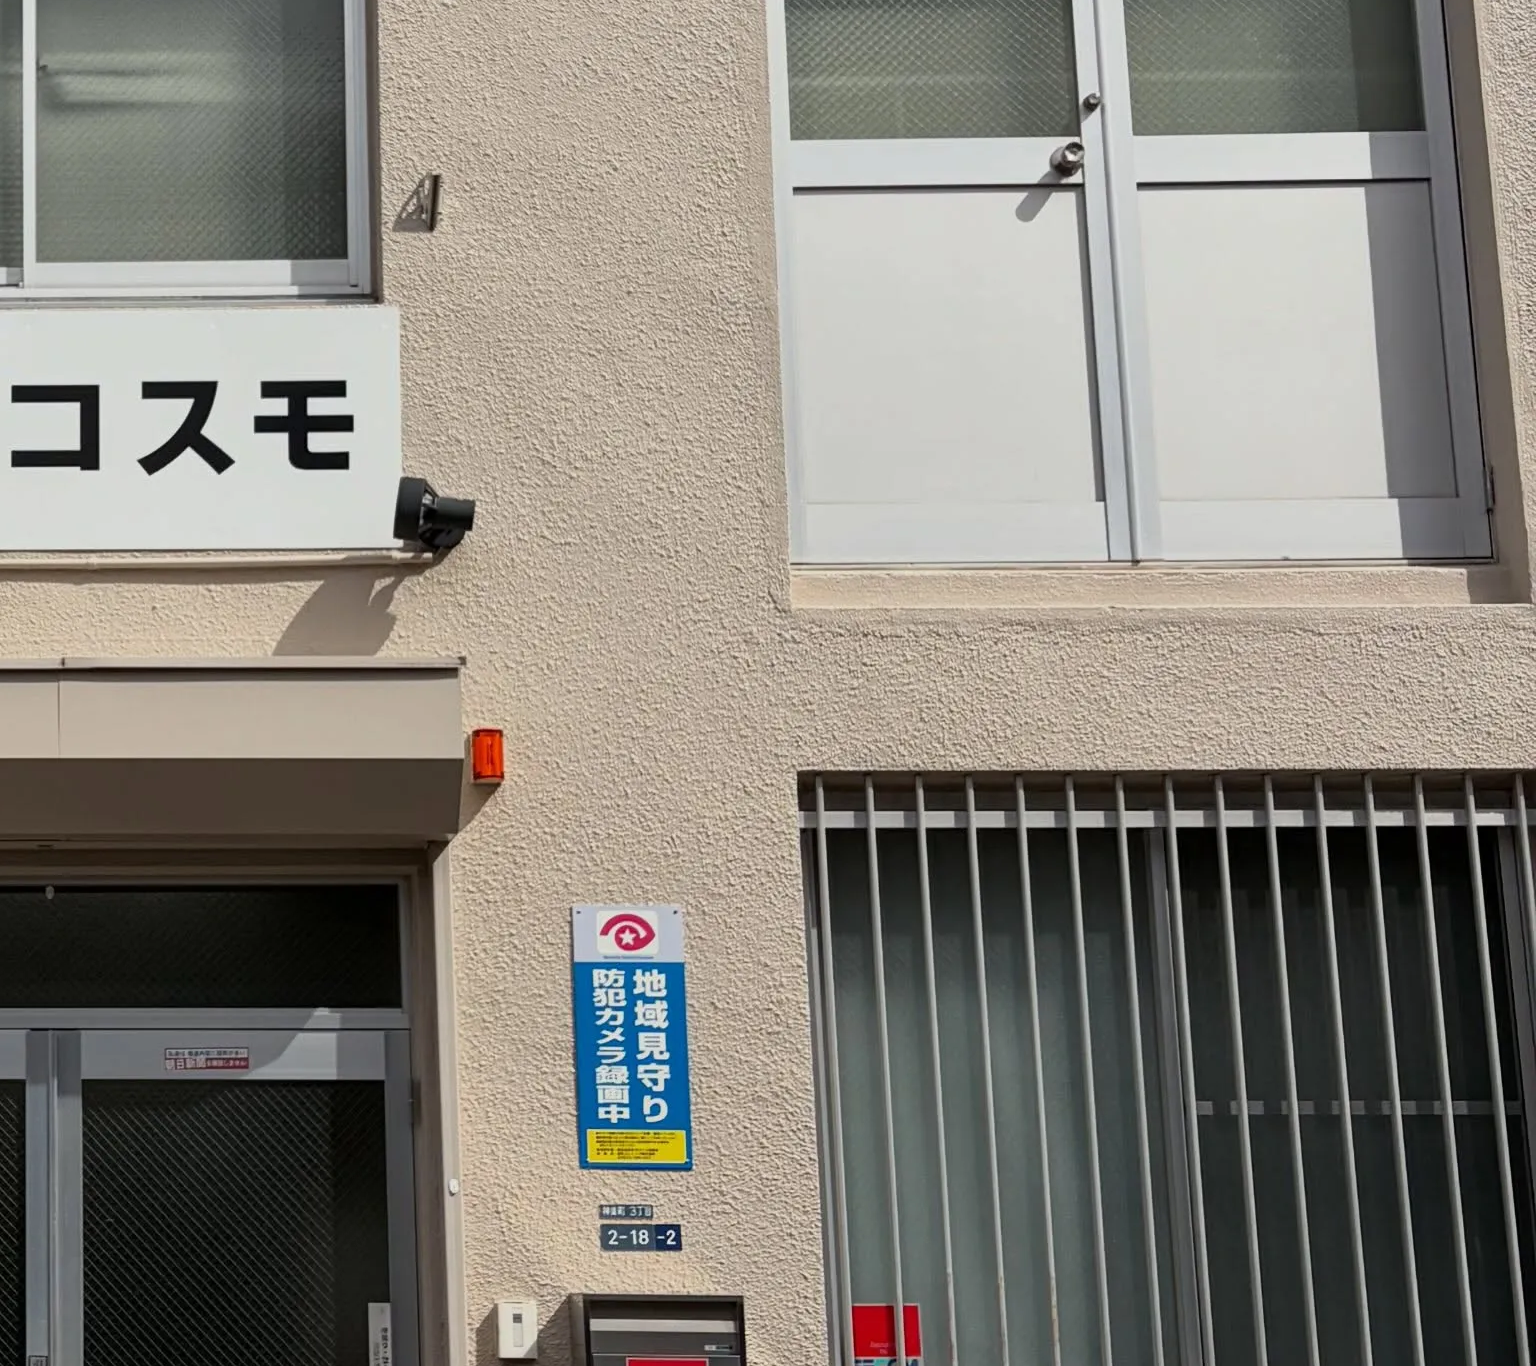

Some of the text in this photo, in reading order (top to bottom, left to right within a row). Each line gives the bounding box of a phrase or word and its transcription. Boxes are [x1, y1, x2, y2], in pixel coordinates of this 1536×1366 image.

[10, 380, 355, 476] コスモ
[592, 968, 630, 1124] 防犯カメラ録画中
[632, 969, 671, 1123] 地域見守り
